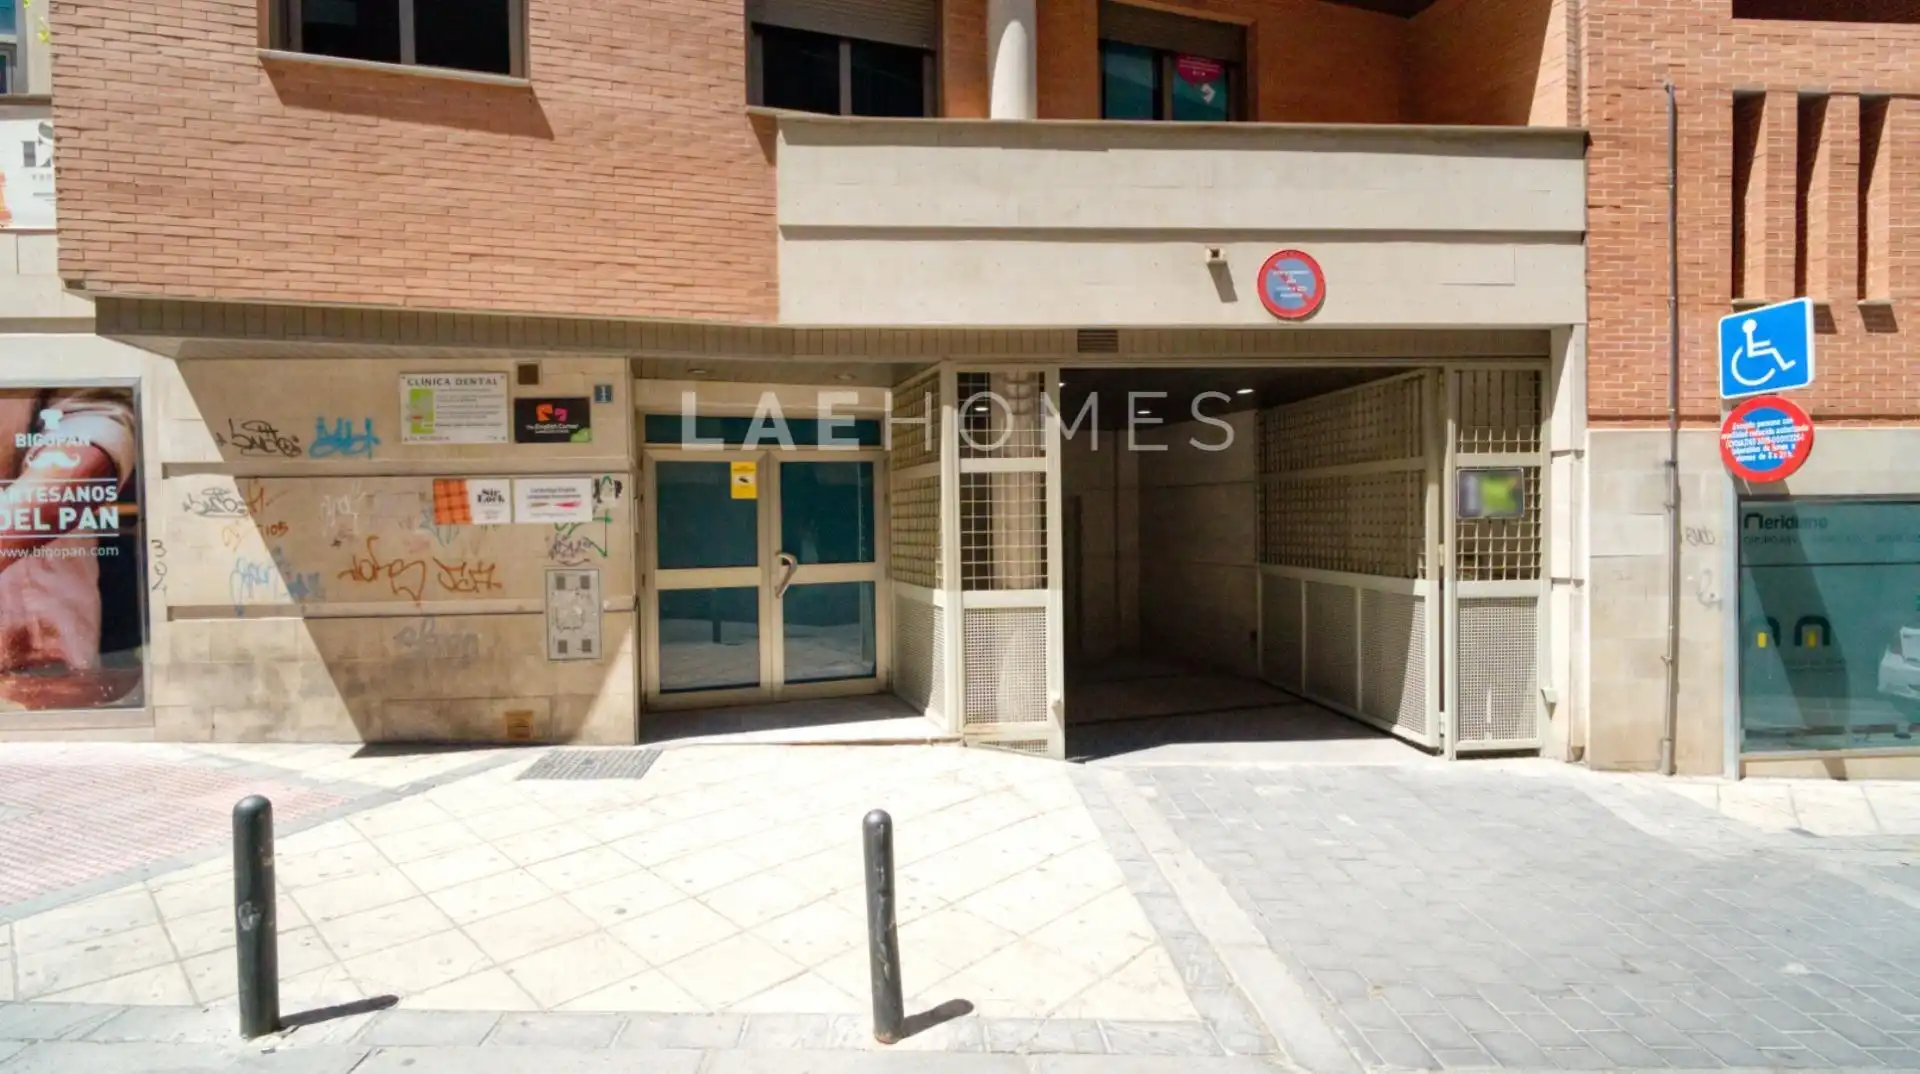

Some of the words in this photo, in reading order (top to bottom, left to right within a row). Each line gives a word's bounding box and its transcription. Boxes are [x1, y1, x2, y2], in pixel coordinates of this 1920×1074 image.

[407, 375, 451, 386] CLÍNICA
[455, 376, 498, 386] DENTAL
[15, 433, 91, 448] BIGOPAN
[58, 506, 119, 530] PAN
